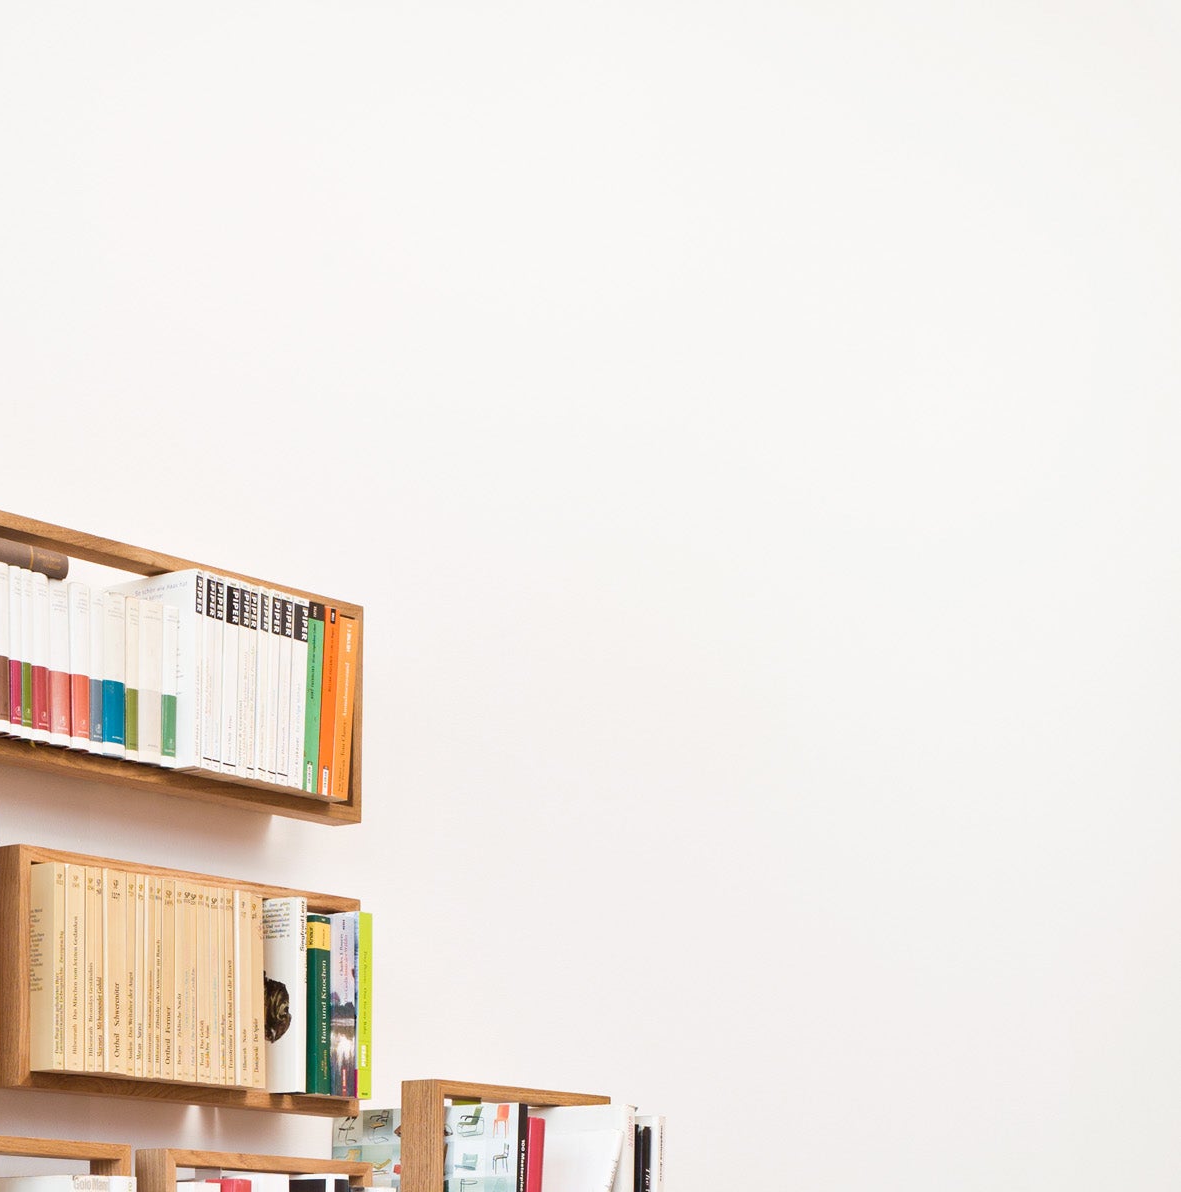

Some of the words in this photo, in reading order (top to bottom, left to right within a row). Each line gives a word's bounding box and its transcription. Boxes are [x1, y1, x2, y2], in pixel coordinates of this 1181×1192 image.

[207, 584, 215, 616] PIPER
[230, 592, 239, 624] PIPER
[242, 594, 250, 626] PIPER
[261, 599, 269, 630] PIPER
[272, 601, 280, 633] PIPER
[73, 1179, 91, 1191] Golo
